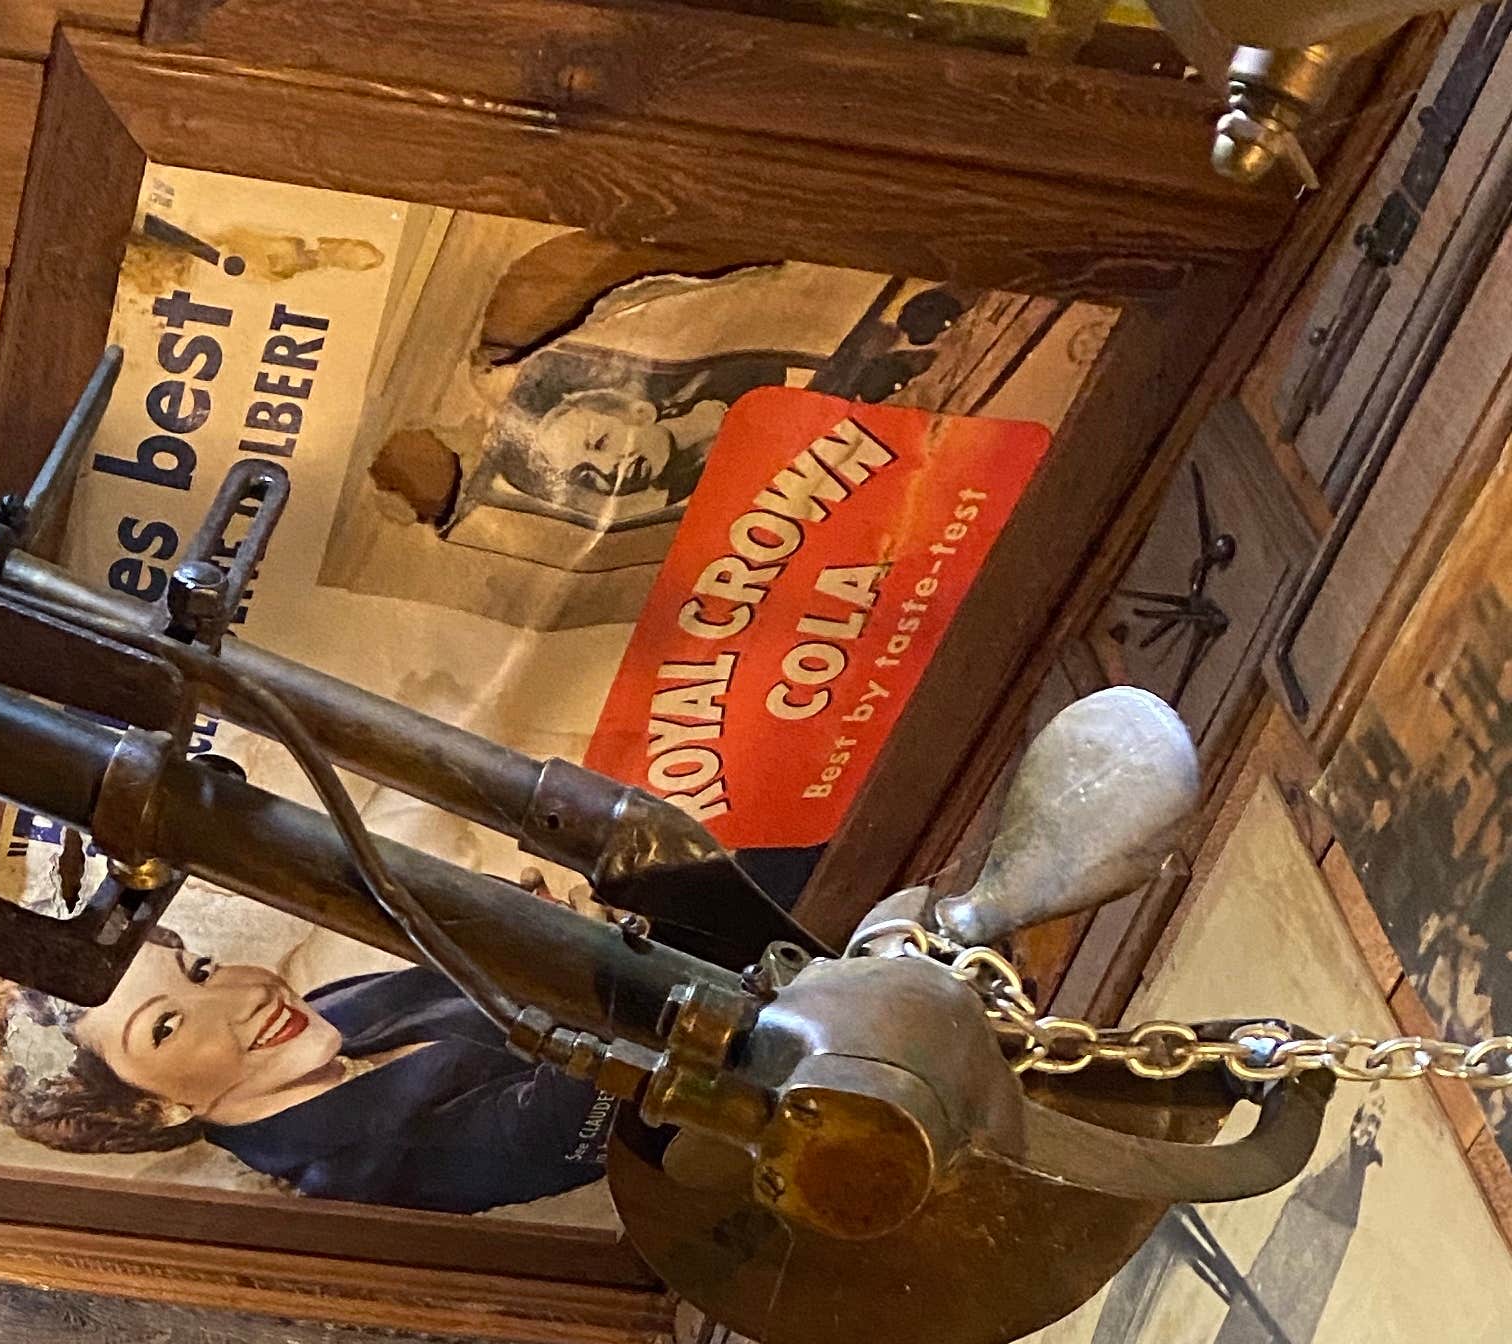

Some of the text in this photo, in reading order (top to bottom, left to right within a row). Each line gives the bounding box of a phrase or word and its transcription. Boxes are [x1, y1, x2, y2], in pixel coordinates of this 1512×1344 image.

[646, 417, 899, 822] ROYAL CROWN
[766, 561, 893, 721] COLA
[803, 487, 987, 799] Best by taste-test
[579, 1089, 615, 1139] CLAUDE
